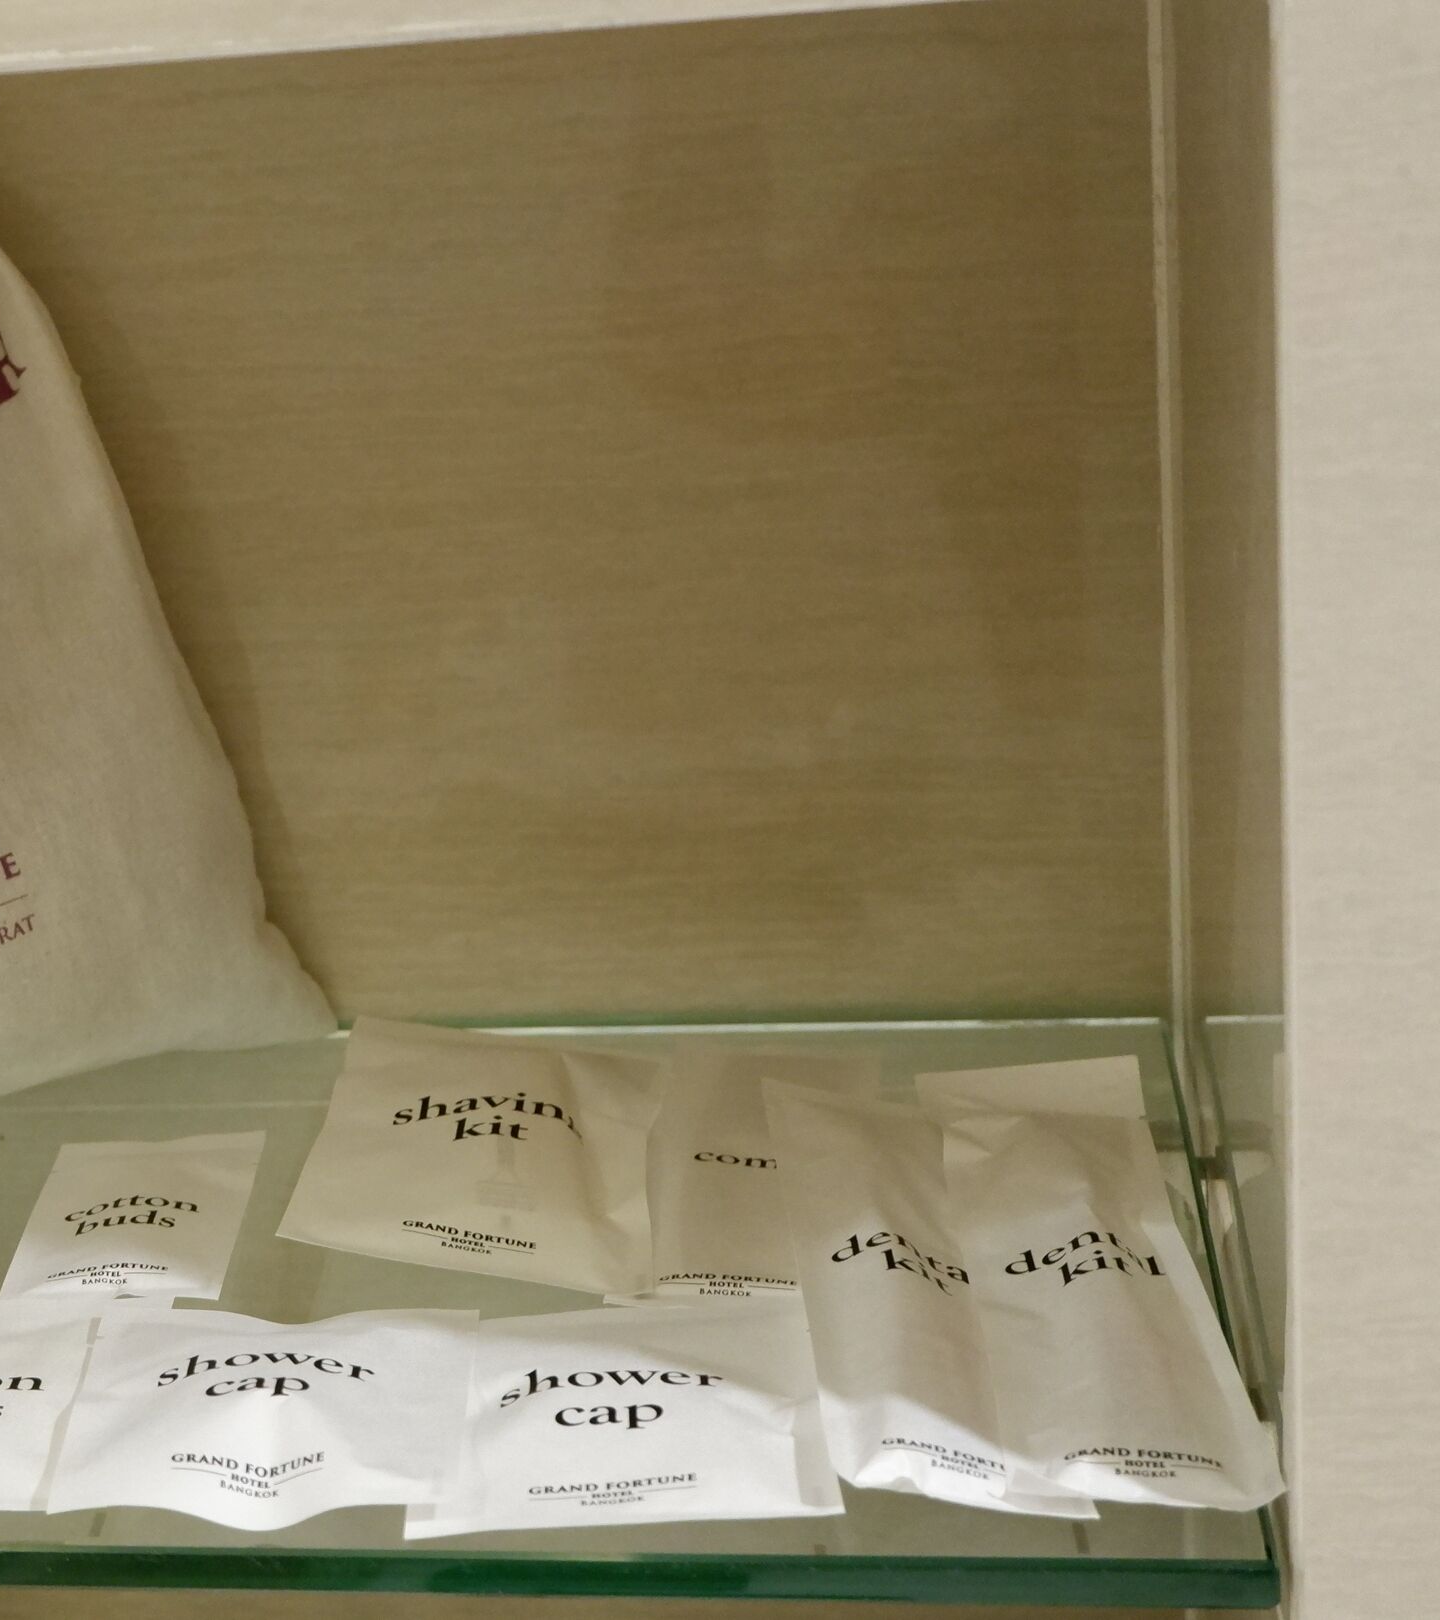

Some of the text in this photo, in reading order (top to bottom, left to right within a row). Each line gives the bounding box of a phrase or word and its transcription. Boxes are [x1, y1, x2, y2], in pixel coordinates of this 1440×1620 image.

[453, 1115, 528, 1141] kit
[694, 1152, 777, 1169] com
[64, 1195, 200, 1222] cotton
[75, 1210, 176, 1236] buds
[403, 1220, 536, 1249] GRAND FORTUNE
[451, 1237, 485, 1248] HOTEL
[442, 1242, 492, 1254] BANGKOK
[832, 1232, 969, 1284] denta
[48, 1262, 168, 1278] GRAND FORTUNE
[1058, 1250, 1134, 1287] kit
[660, 1273, 797, 1285] GRAND FORTUNE
[700, 1288, 751, 1296] BANGKOK
[158, 1352, 375, 1387] shower
[206, 1376, 310, 1397] cap
[500, 1369, 723, 1408] shower
[555, 1404, 663, 1430] cap
[882, 1438, 1006, 1471] GRAND FORT
[941, 1455, 978, 1469] HOTEL
[1064, 1447, 1130, 1460] GRAND
[171, 1451, 324, 1478] GRAND FORTUNE
[1115, 1468, 1176, 1478] BANGKOK
[1124, 1460, 1166, 1468] HOTEL
[220, 1480, 280, 1498] BANGKOK
[231, 1474, 270, 1488] HOTEL
[528, 1472, 698, 1494] GRAND FORTUNE
[592, 1490, 634, 1498] HOTEL
